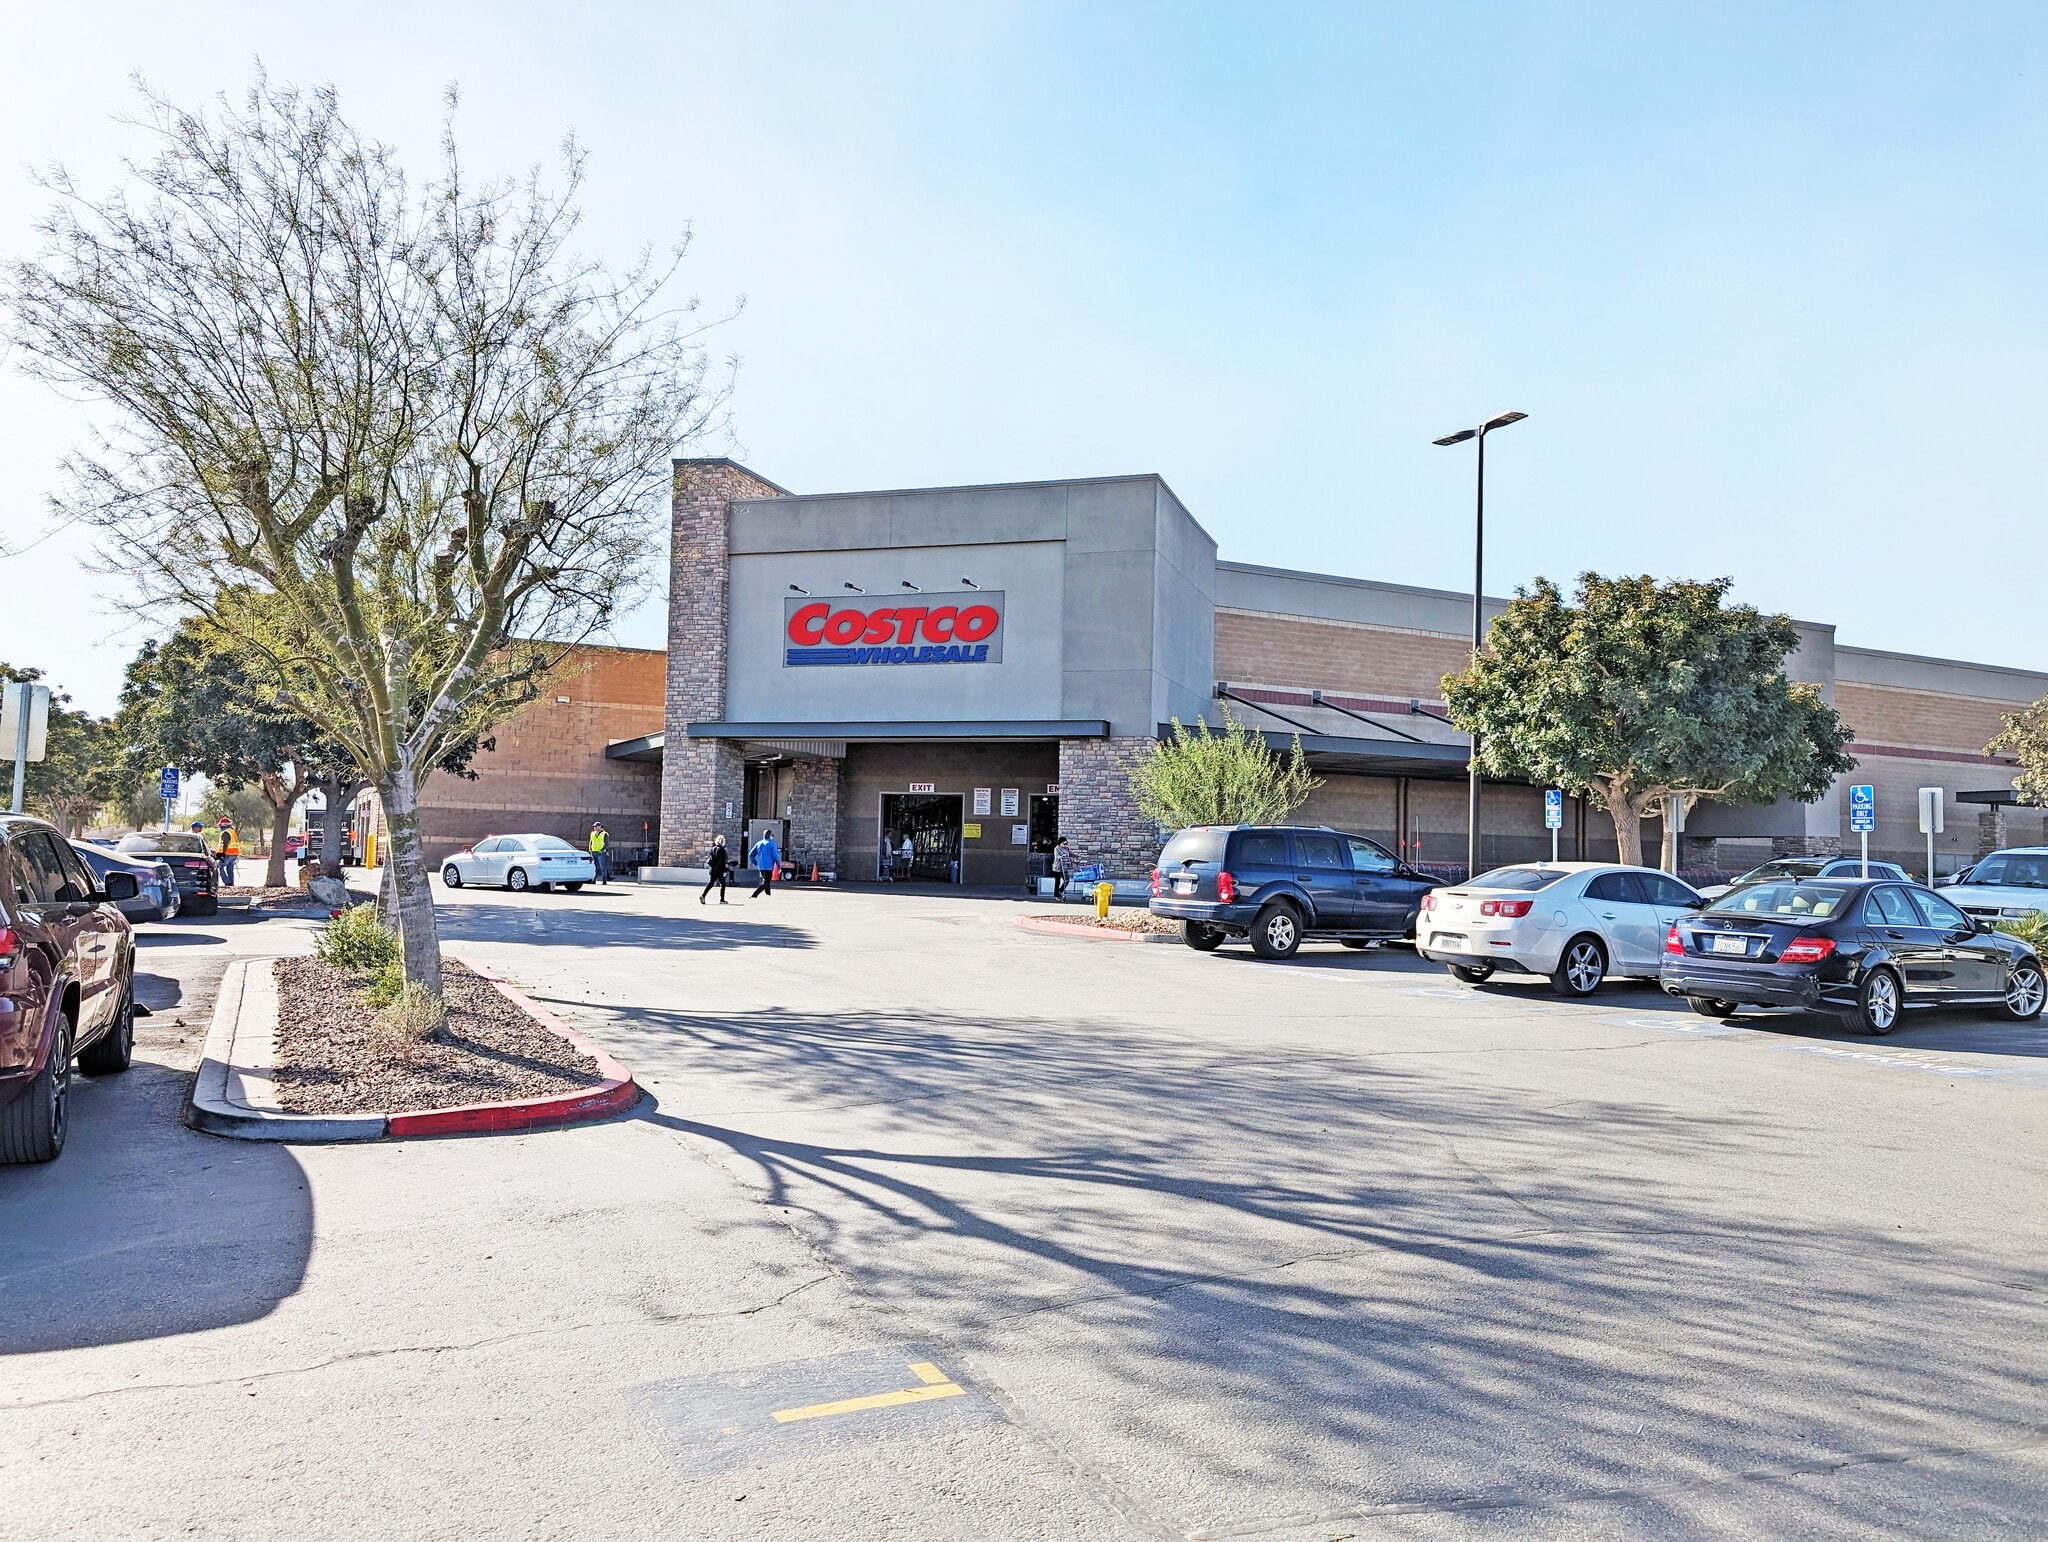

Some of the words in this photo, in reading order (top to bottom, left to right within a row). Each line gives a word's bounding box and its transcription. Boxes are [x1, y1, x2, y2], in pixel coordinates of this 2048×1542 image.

[788, 603, 999, 646] COSTCO
[850, 645, 989, 664] WHOLESALE
[912, 784, 932, 792] EXIT
